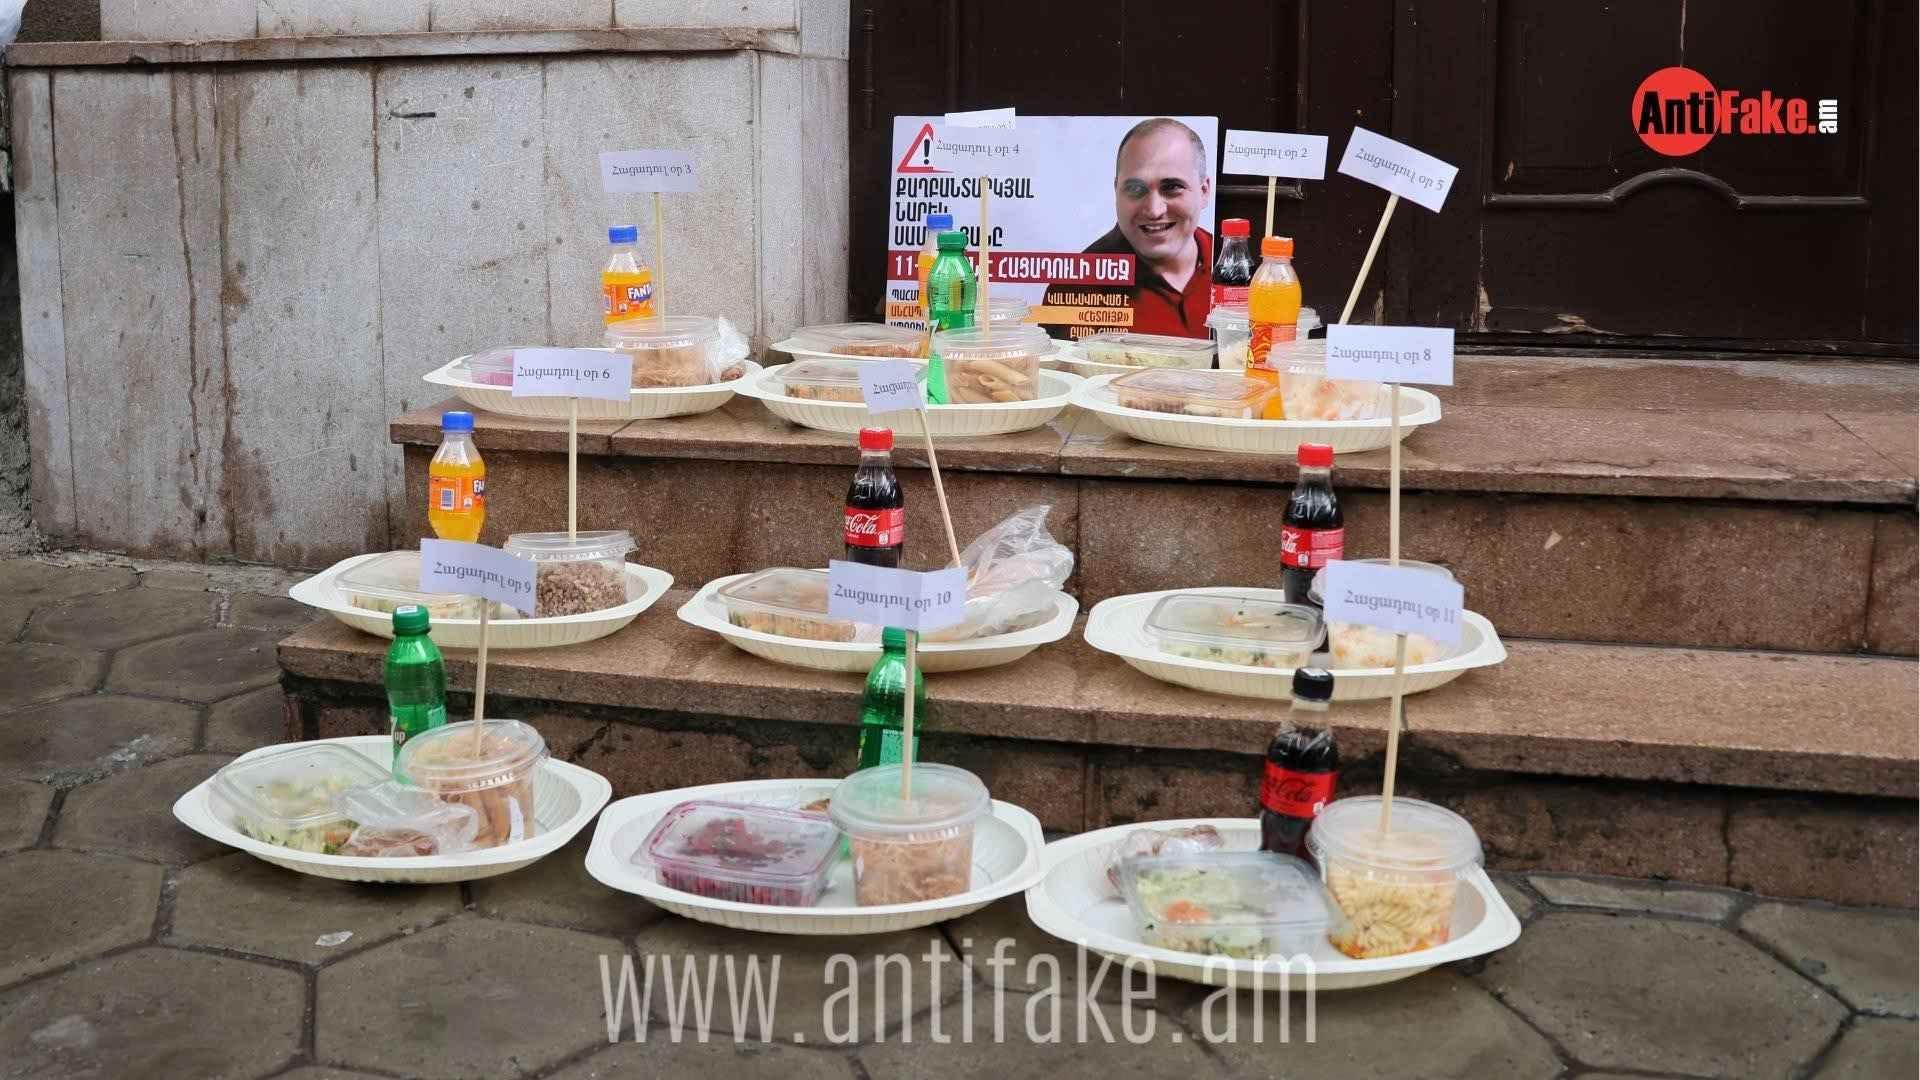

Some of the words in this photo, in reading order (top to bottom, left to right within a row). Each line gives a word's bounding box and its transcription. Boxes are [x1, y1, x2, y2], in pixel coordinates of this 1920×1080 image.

[1012, 143, 1020, 154] 4
[1301, 147, 1308, 158] 2
[685, 164, 692, 174] 3
[1436, 179, 1446, 191] 5
[1423, 348, 1432, 361] 8
[602, 368, 610, 379] 6
[525, 581, 532, 594] 9
[936, 591, 952, 605] 10
